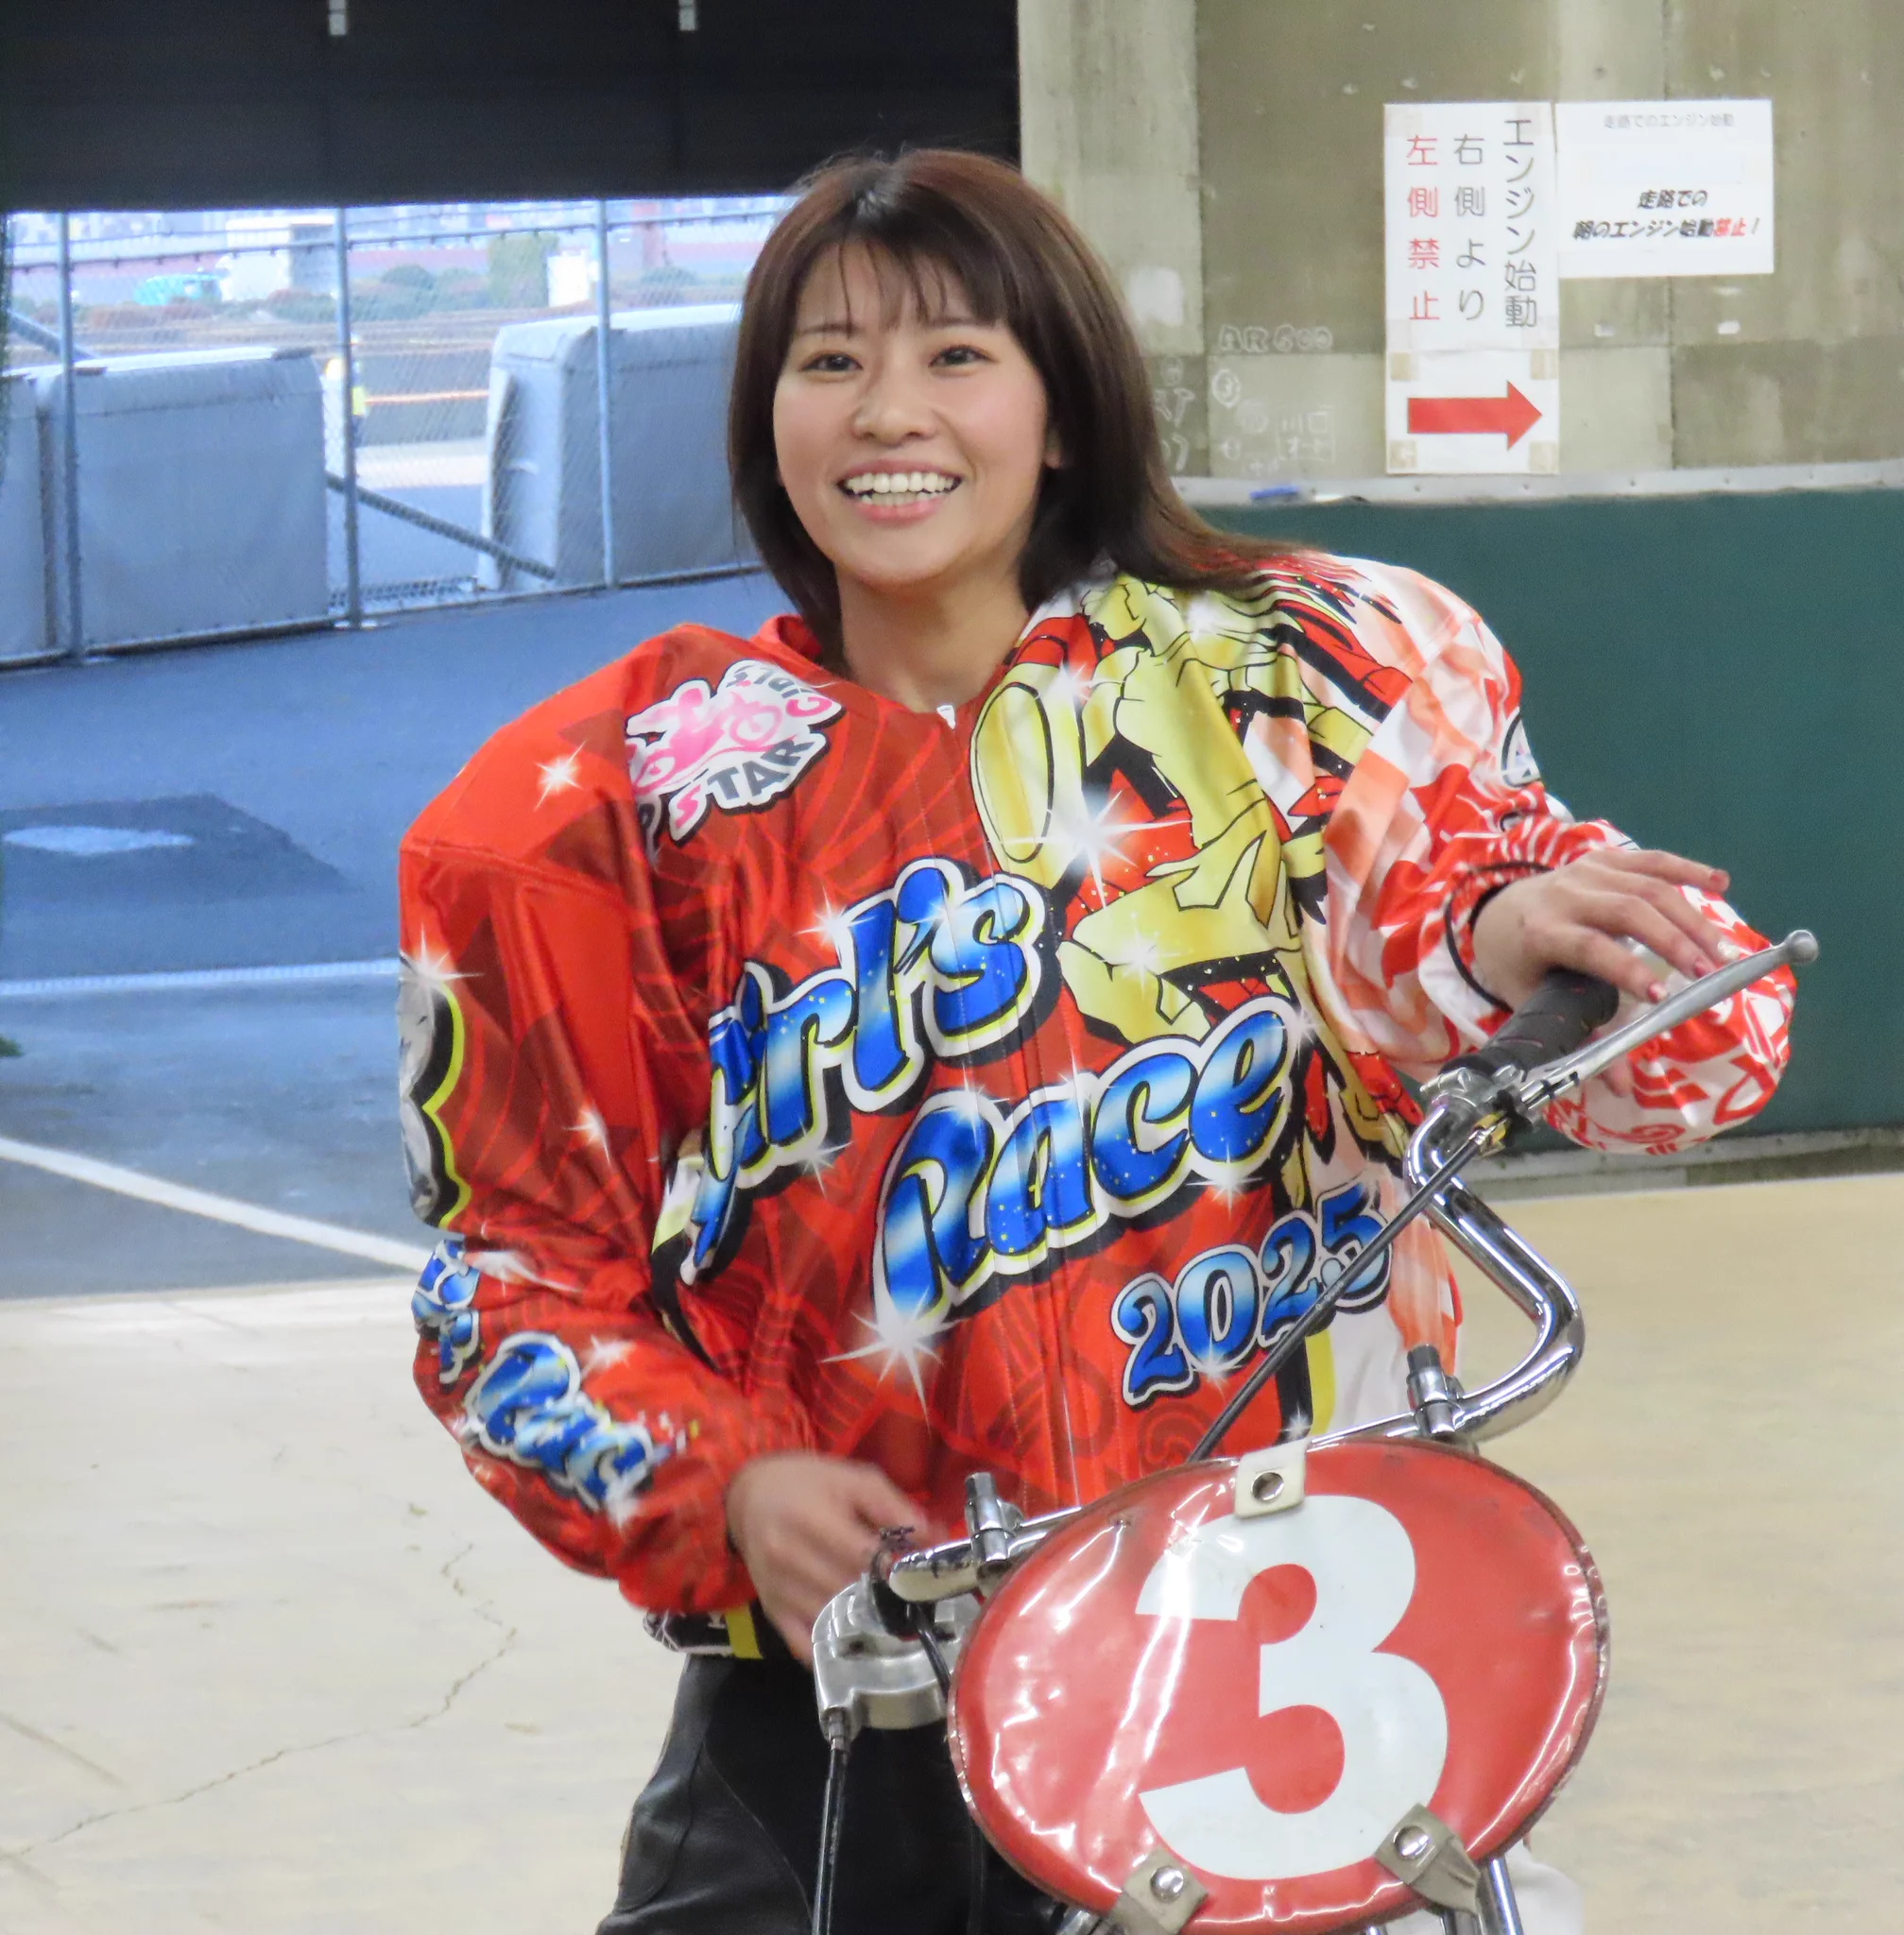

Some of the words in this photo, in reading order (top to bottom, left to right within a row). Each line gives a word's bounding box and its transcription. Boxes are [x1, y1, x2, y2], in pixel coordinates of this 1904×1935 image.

[1406, 133, 1441, 321] 左側禁止
[1453, 133, 1486, 320] 右側より
[1502, 118, 1538, 328] エンジン始動
[879, 1002, 1302, 1321] Race
[1114, 1181, 1391, 1401] 2025
[1135, 1495, 1448, 1880] 3
